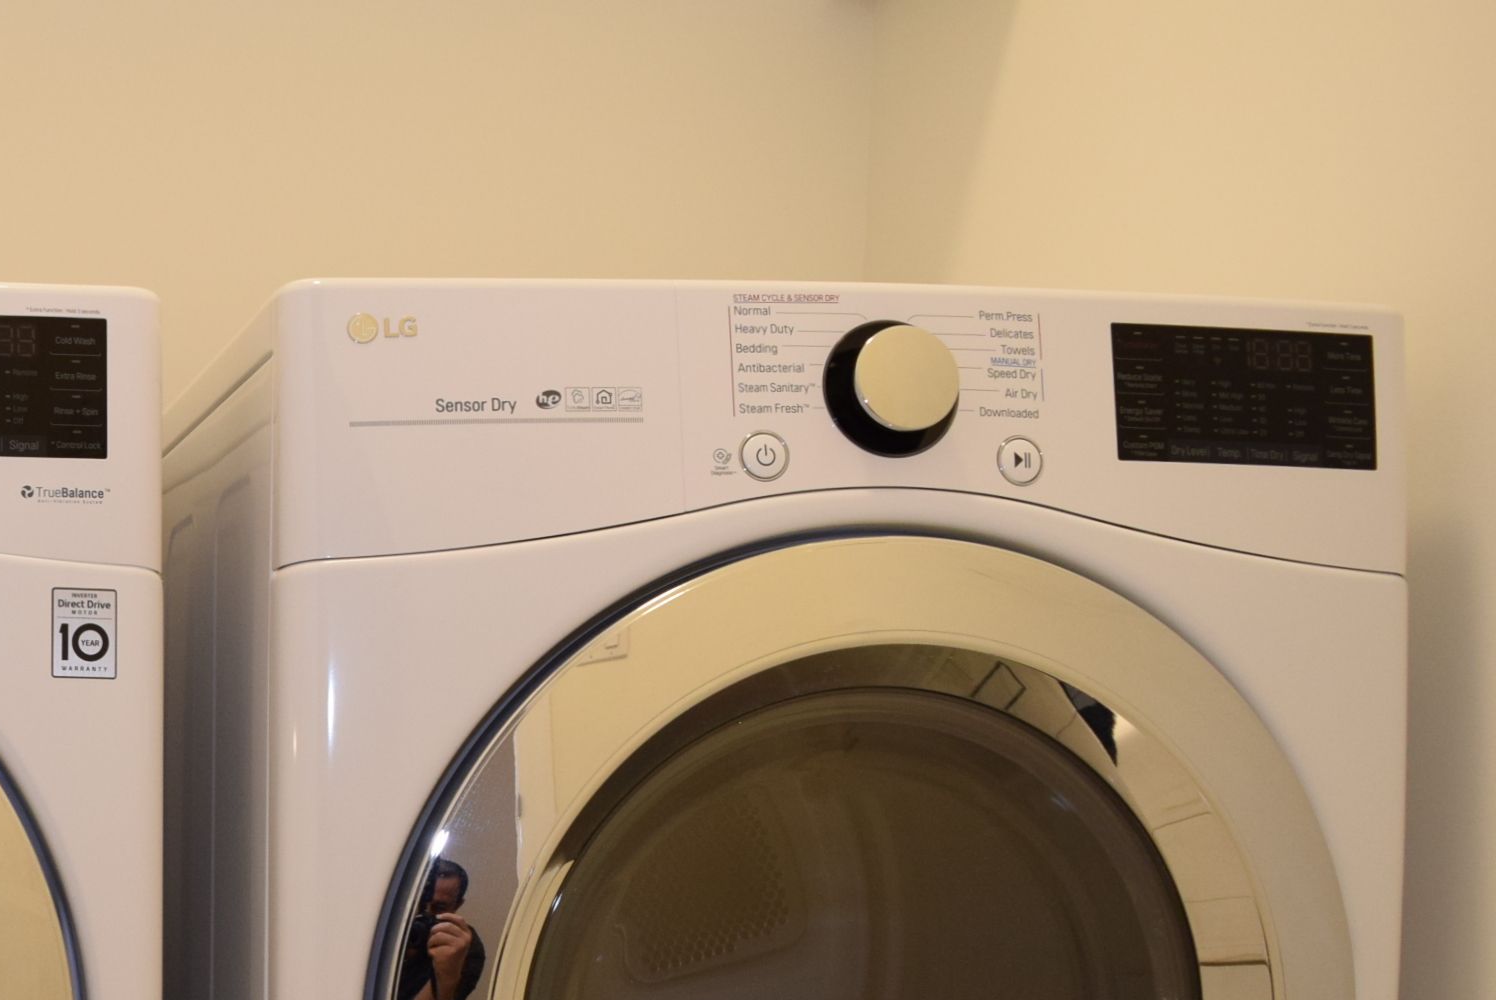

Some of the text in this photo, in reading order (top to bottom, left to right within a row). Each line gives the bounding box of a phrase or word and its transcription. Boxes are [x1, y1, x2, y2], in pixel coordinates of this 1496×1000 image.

[733, 294, 760, 302] STEAM
[761, 294, 785, 302] CYCLE
[794, 294, 823, 302] SENSOR
[825, 294, 840, 302] DRY
[733, 305, 771, 316] Normal
[735, 323, 794, 335] Heavy Duty
[989, 327, 1035, 340] Delicates
[735, 343, 779, 355] Bedding
[1000, 344, 1036, 356] Towels
[738, 362, 805, 373] Antibacterial
[987, 367, 1037, 381] Speed Dry
[738, 382, 768, 393] Steam
[1004, 388, 1038, 401] Air Dry
[435, 397, 517, 415] Sensor Dry
[739, 402, 772, 414] Steam
[979, 406, 1040, 419] Downloaded
[8, 440, 40, 452] Signal
[57, 599, 111, 609] Direct Drive
[59, 623, 110, 662] 10
